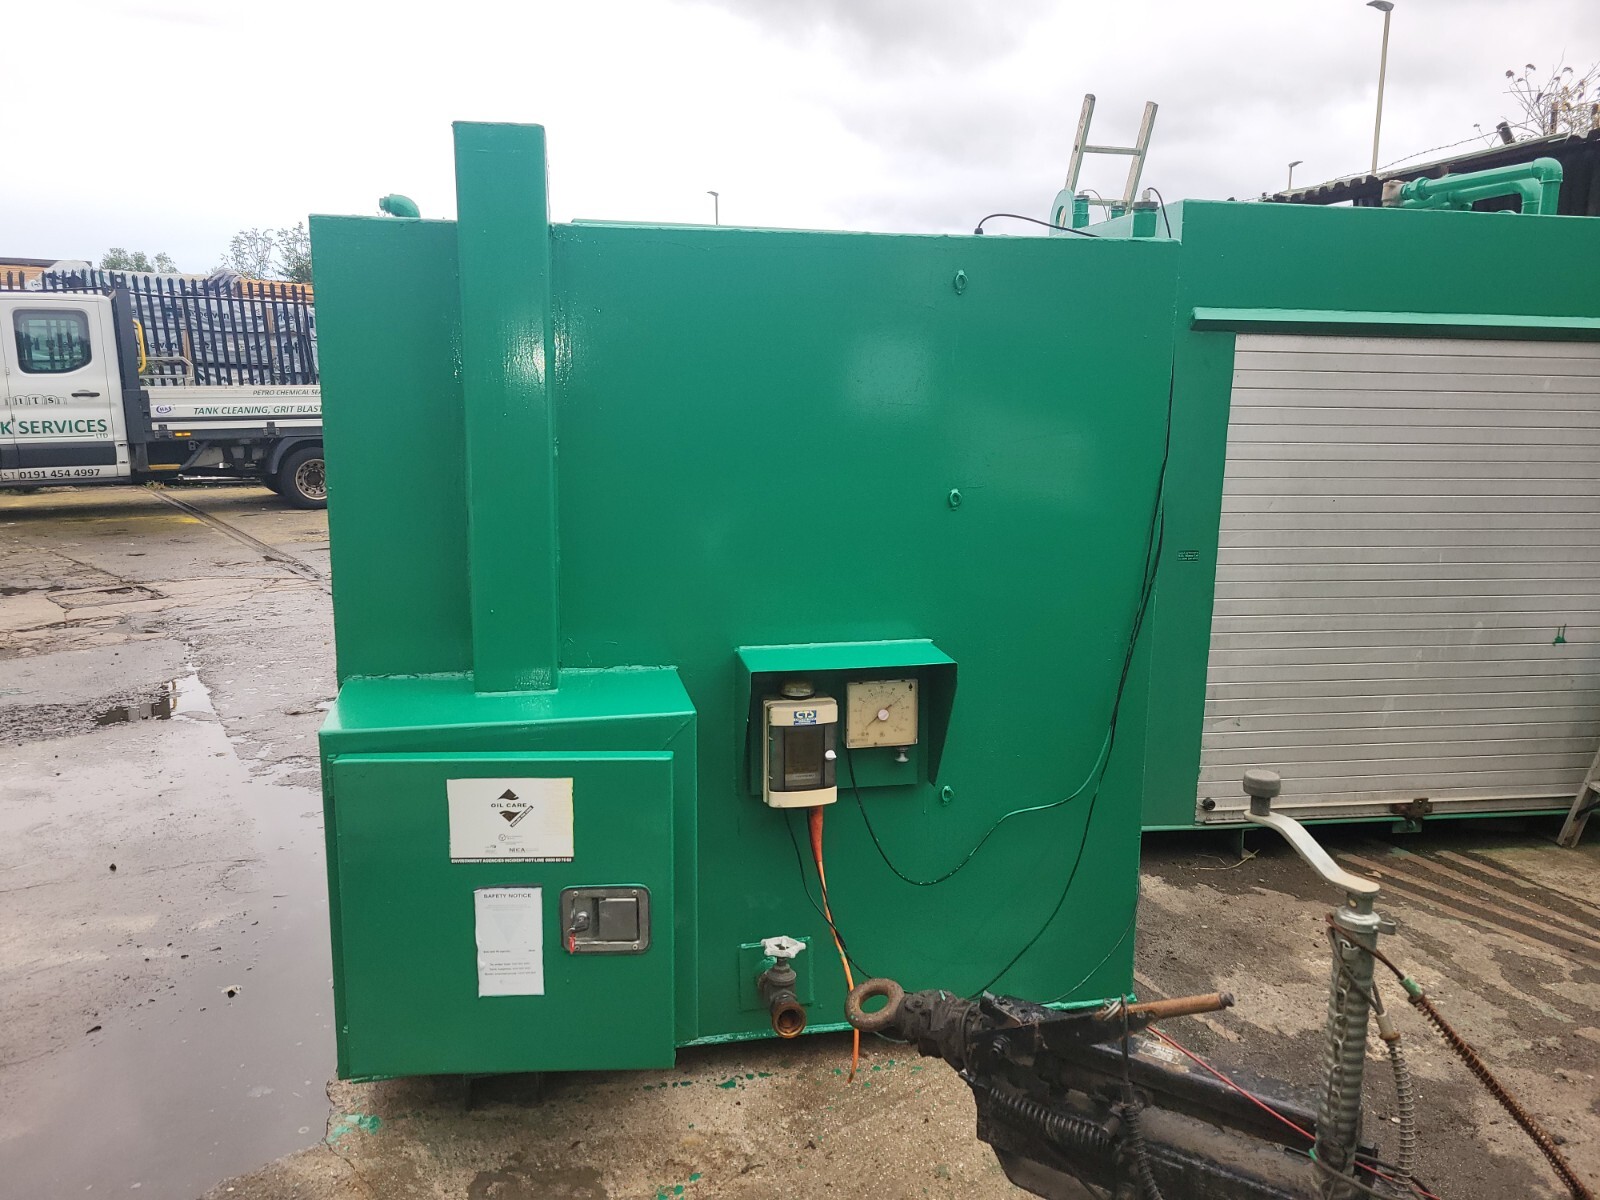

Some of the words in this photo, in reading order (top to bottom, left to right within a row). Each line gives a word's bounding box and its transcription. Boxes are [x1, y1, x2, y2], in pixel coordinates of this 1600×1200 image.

[193, 406, 218, 415] TANK
[221, 405, 270, 415] CLEANING,
[273, 405, 295, 414] GRIT
[19, 419, 107, 434] SERVICES
[20, 470, 47, 479] 0191
[50, 469, 71, 478] 454
[74, 468, 100, 477] 4997
